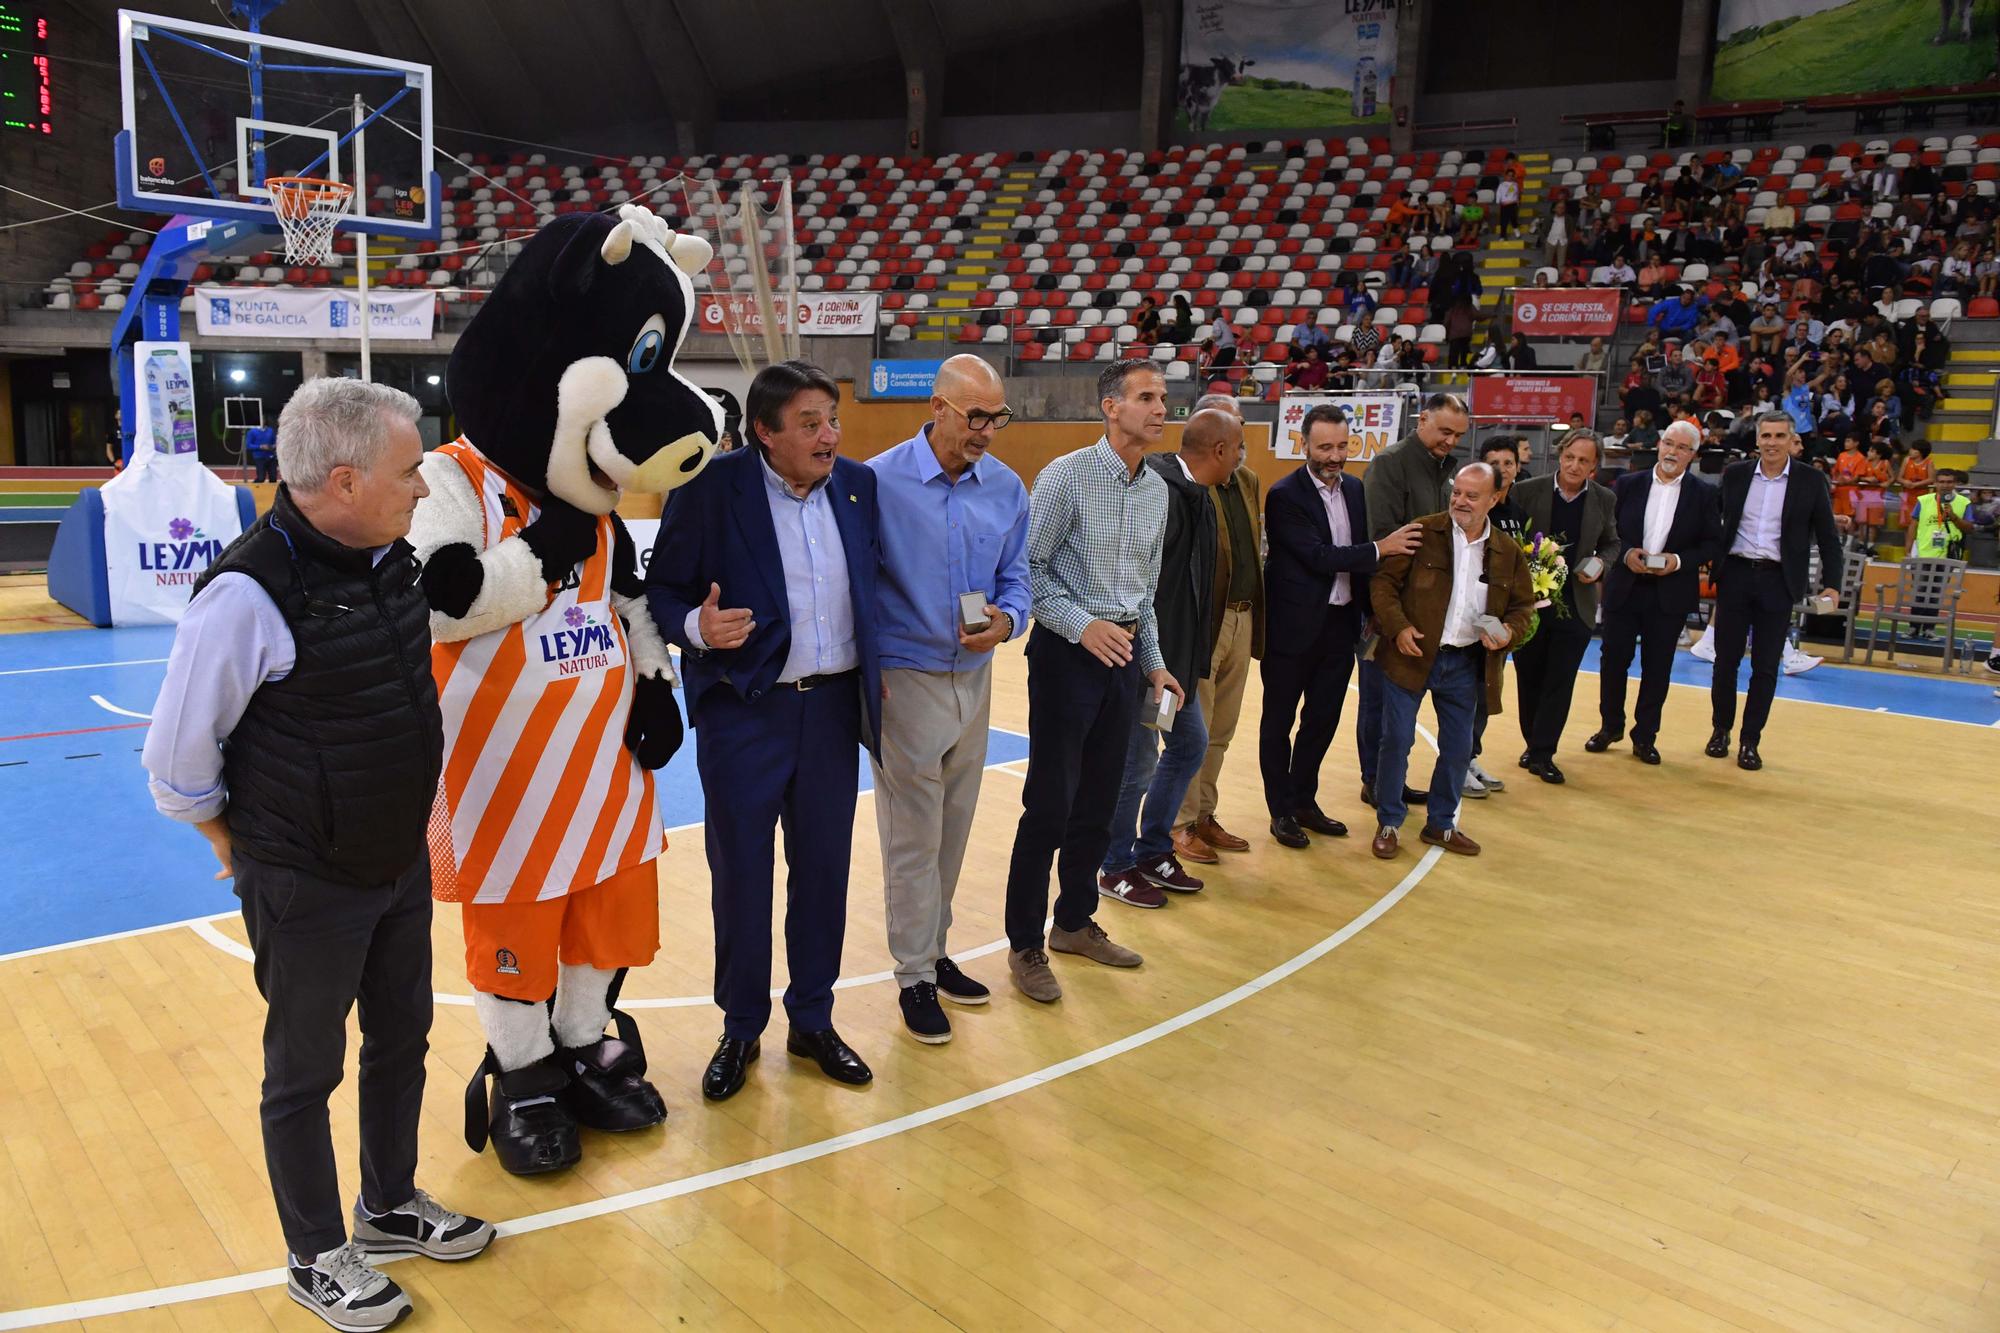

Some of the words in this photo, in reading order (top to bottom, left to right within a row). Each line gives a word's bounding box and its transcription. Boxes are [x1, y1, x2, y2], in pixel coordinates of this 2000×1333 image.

[235, 301, 280, 312] XUNTA
[353, 303, 395, 314] XNTA
[817, 302, 823, 312] A
[825, 299, 859, 312] CORUÑA
[1541, 303, 1551, 312] SE
[1553, 303, 1570, 312] CHE
[235, 313, 252, 324] DE
[255, 313, 308, 325] GALICIA
[373, 315, 422, 326] GALICIA
[824, 314, 863, 325] DEPORTE
[1548, 311, 1581, 322] CORUÑA
[1583, 312, 1613, 322] TAMÉN
[890, 379, 917, 387] Concello
[919, 379, 928, 387] da
[156, 572, 200, 586] NATU
[540, 624, 614, 662] LEYMA
[559, 653, 609, 675] NATURA
[1154, 861, 1175, 879] N
[1113, 880, 1134, 897] N
